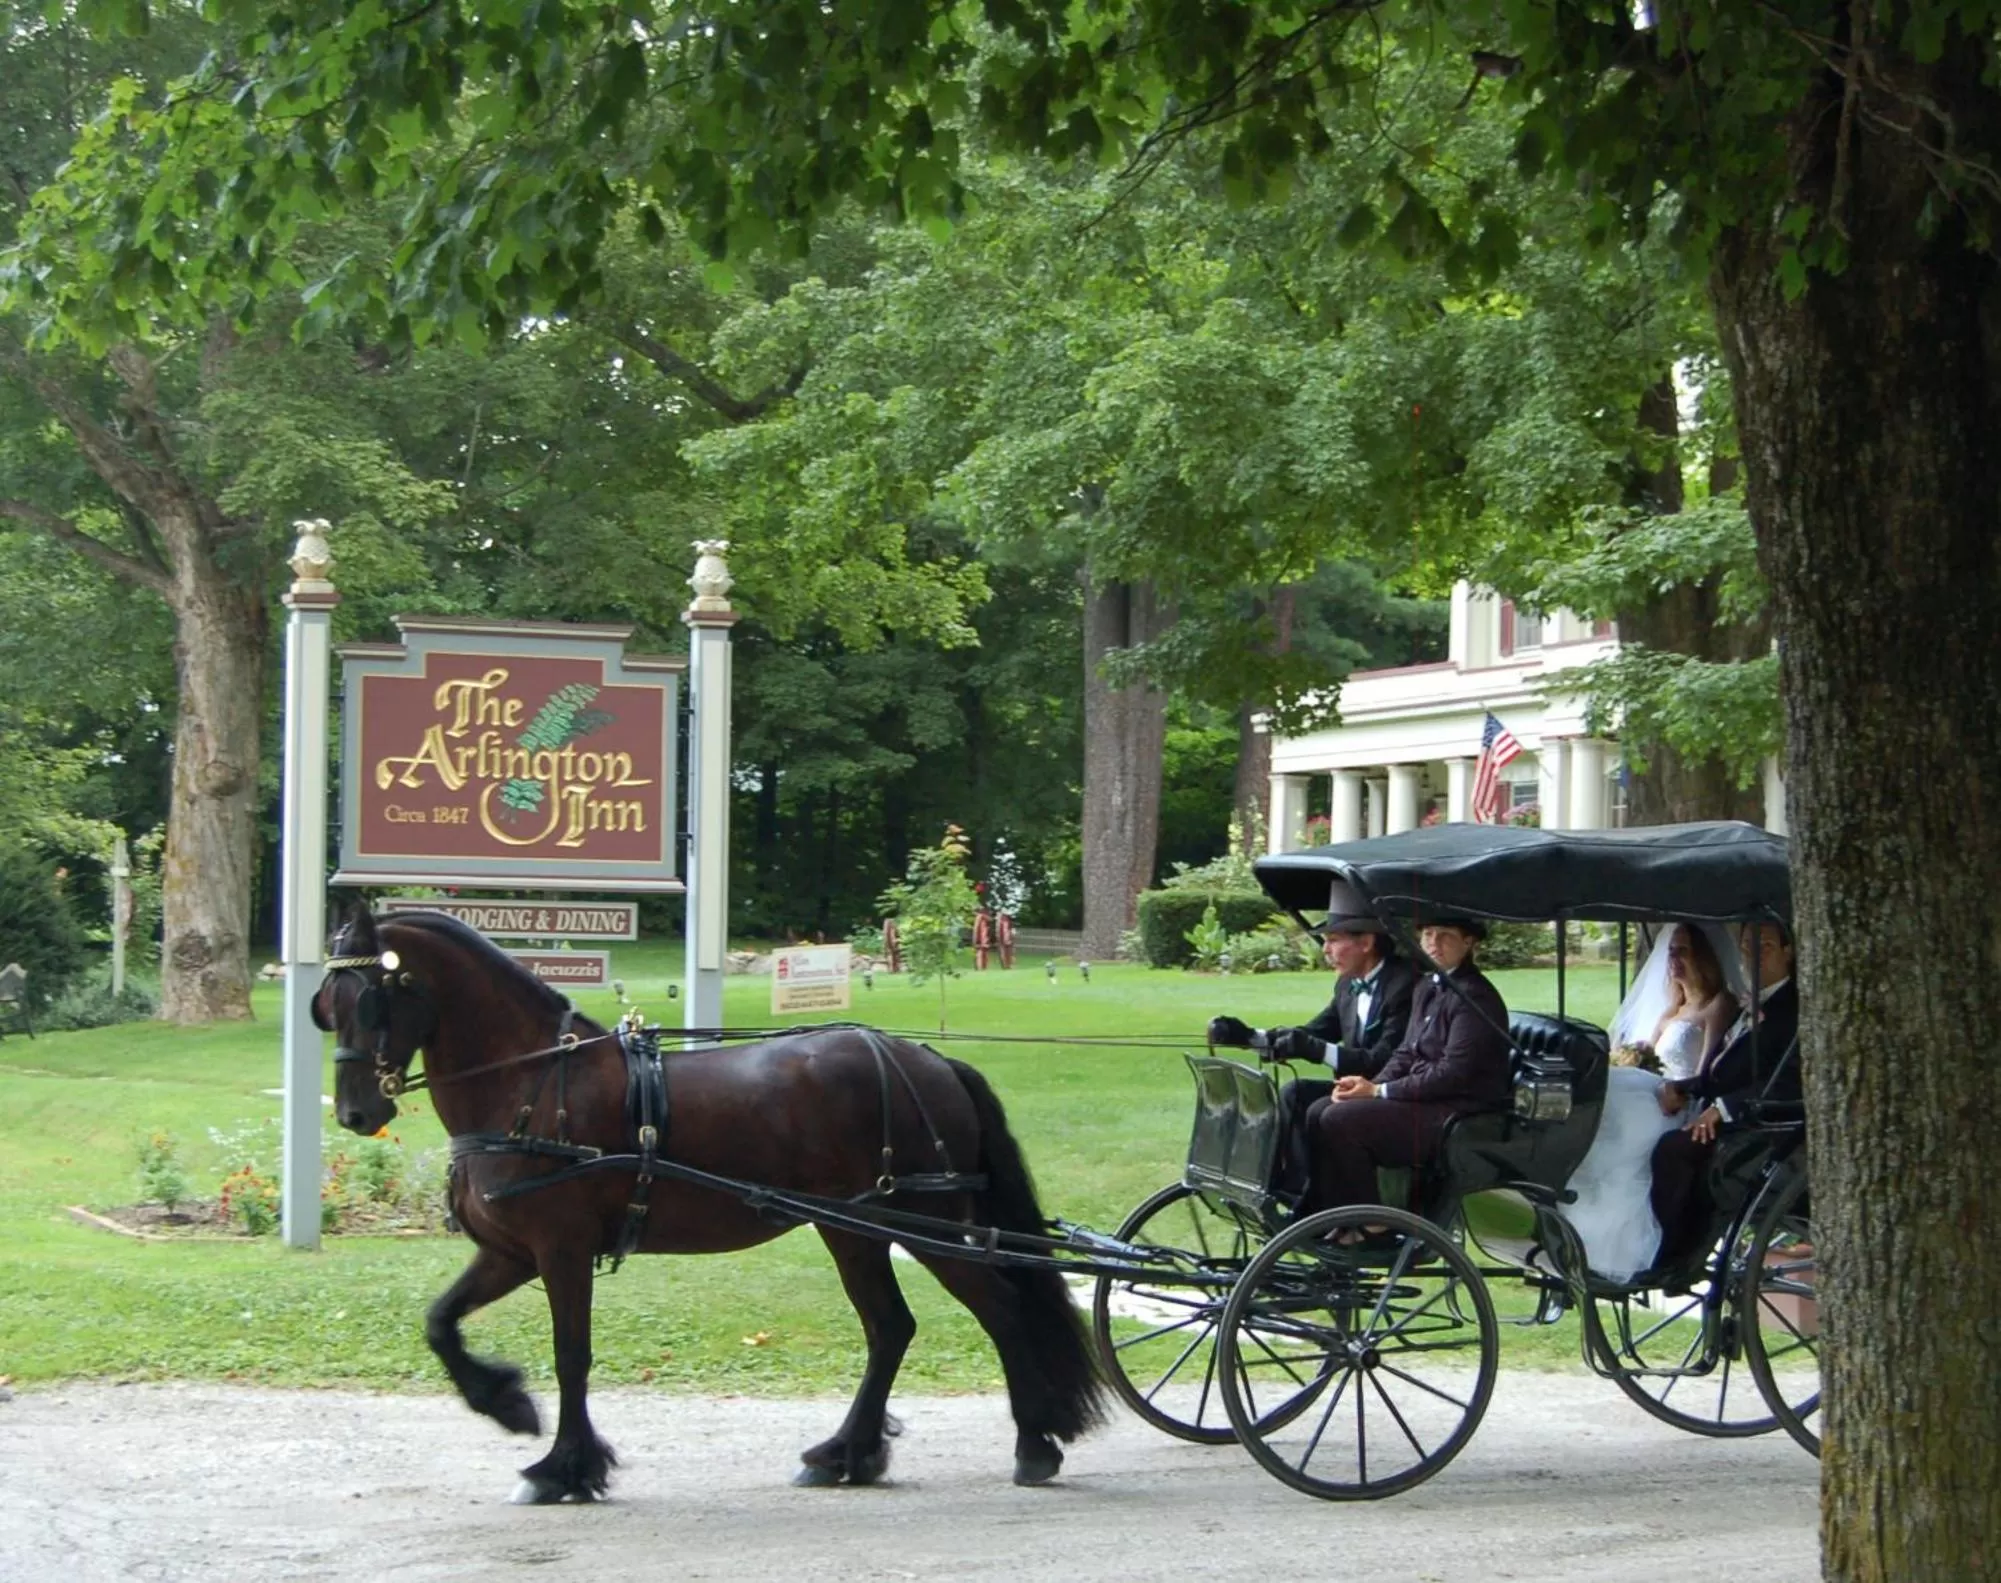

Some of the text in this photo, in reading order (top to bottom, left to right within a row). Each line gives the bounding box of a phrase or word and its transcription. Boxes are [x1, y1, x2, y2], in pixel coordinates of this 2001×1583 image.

[434, 668, 523, 737] The
[376, 724, 652, 845] Arlington
[384, 804, 469, 824] Circa 1847
[556, 784, 648, 847] Inn
[535, 910, 551, 930] &
[555, 910, 626, 932] DINING
[533, 962, 600, 977] Jacuzzis
